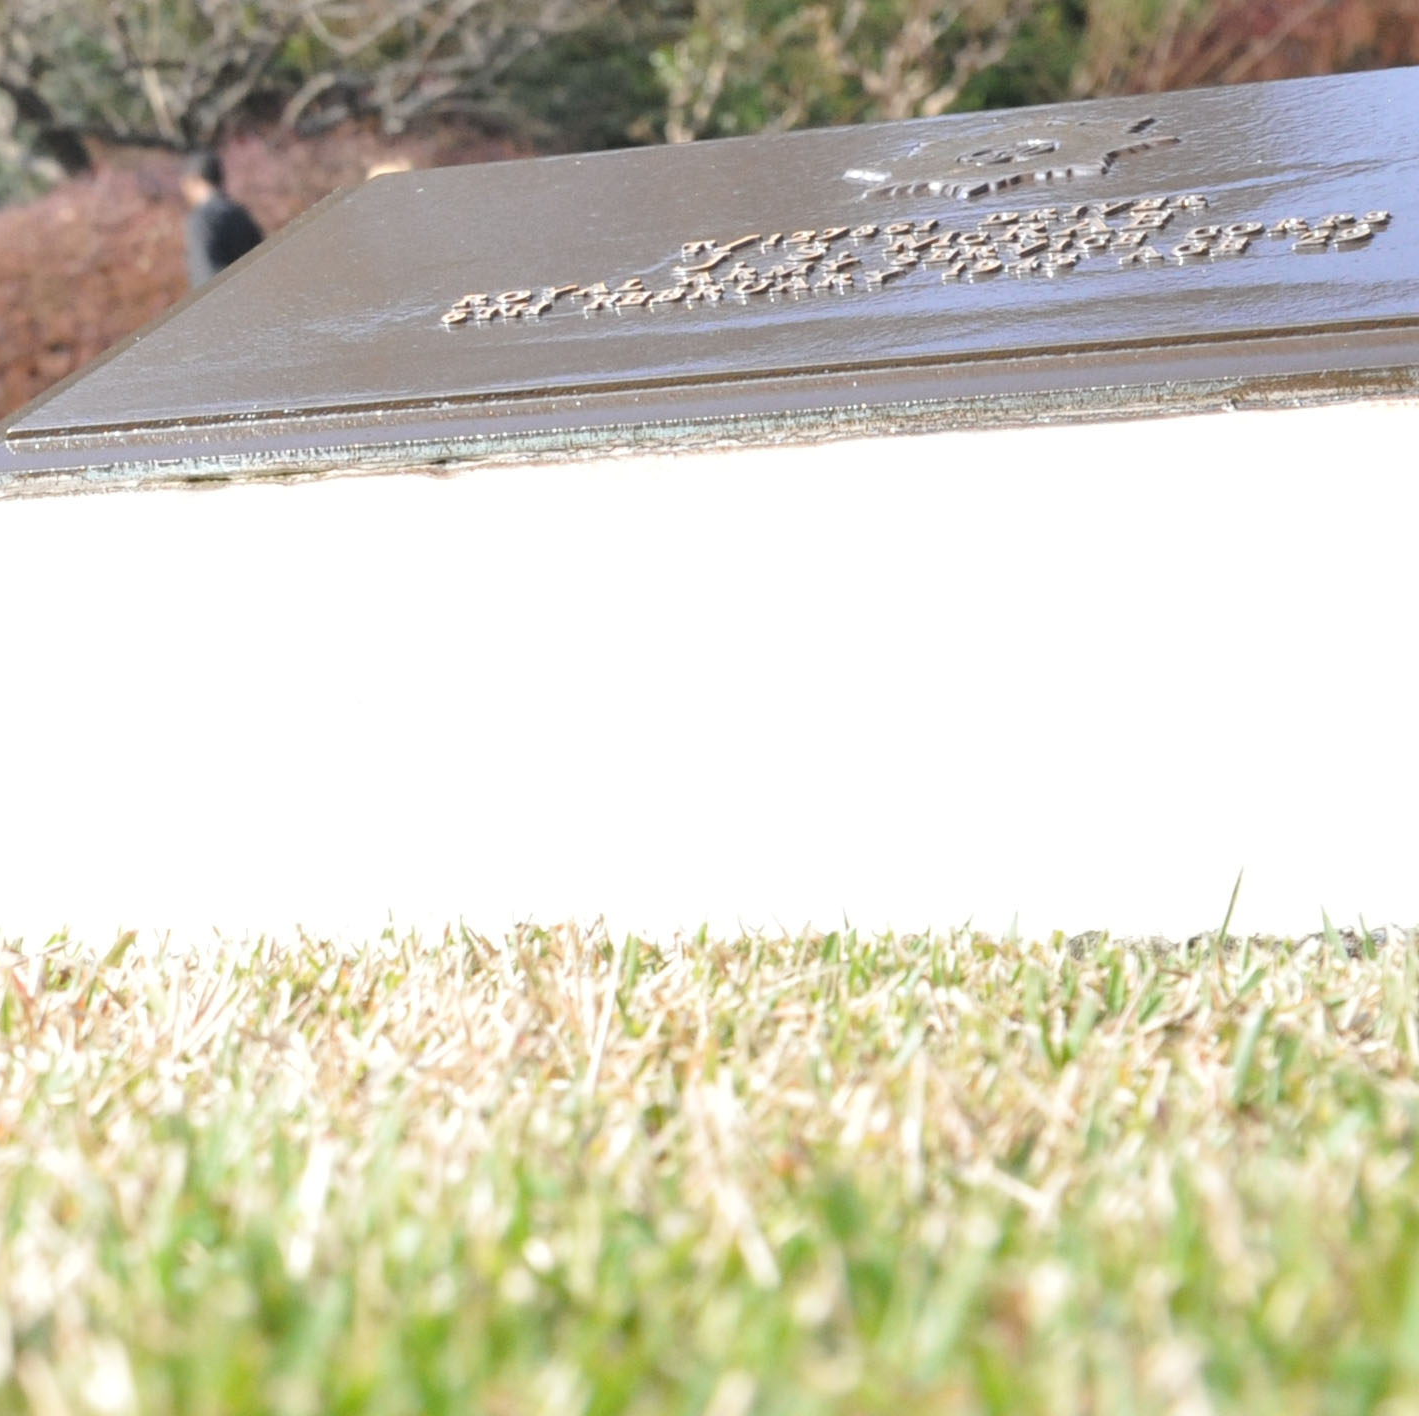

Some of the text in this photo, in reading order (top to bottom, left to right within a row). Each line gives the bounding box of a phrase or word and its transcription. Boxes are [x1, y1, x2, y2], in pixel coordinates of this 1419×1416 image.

[978, 193, 1209, 227] DRIVER
[451, 210, 1391, 309] ROYAL ARMY SERVICE CORPS
[584, 266, 906, 310] FEBRUARY
[1119, 236, 1250, 264] AGE
[1292, 224, 1375, 249] 29
